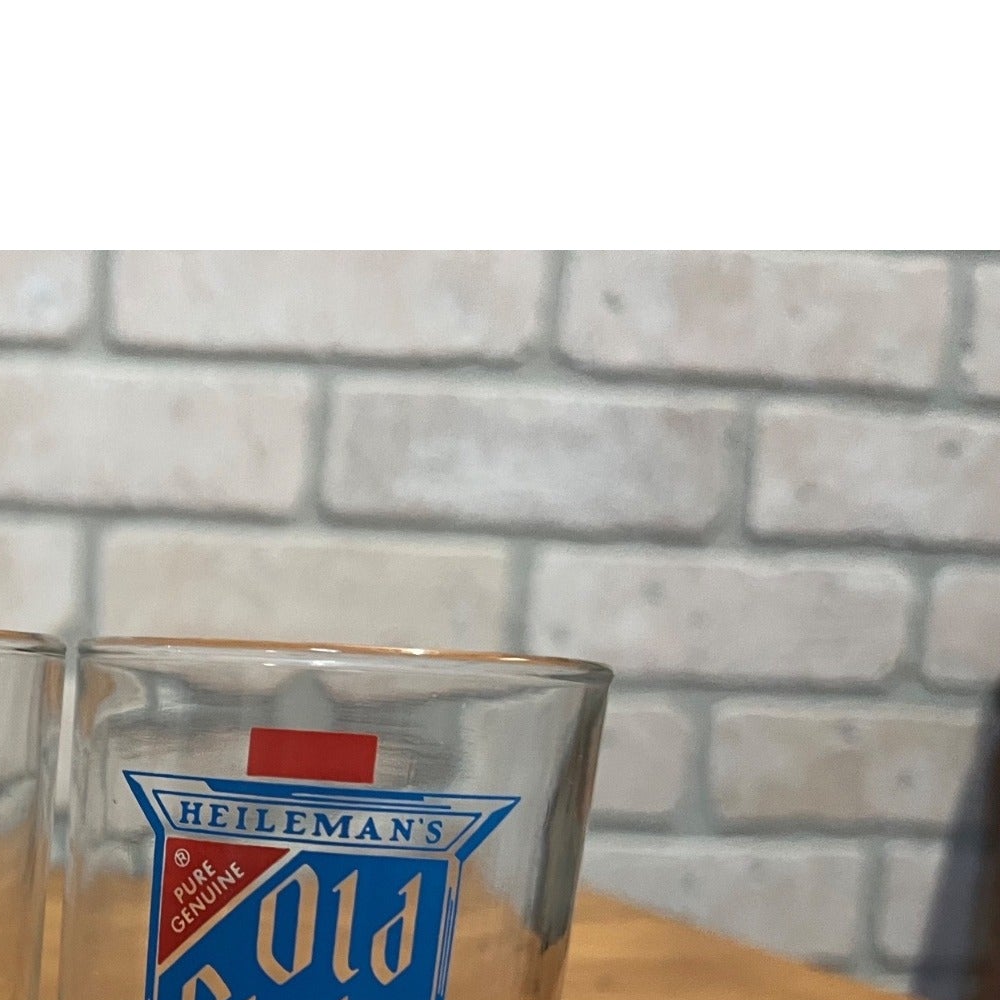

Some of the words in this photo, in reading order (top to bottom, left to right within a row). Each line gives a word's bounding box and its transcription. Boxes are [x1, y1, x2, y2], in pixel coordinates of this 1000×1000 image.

[179, 800, 443, 843] HEILEMAN'S
[170, 861, 245, 933] GENUINE
[173, 859, 216, 904] PURE
[256, 863, 422, 985] Old
